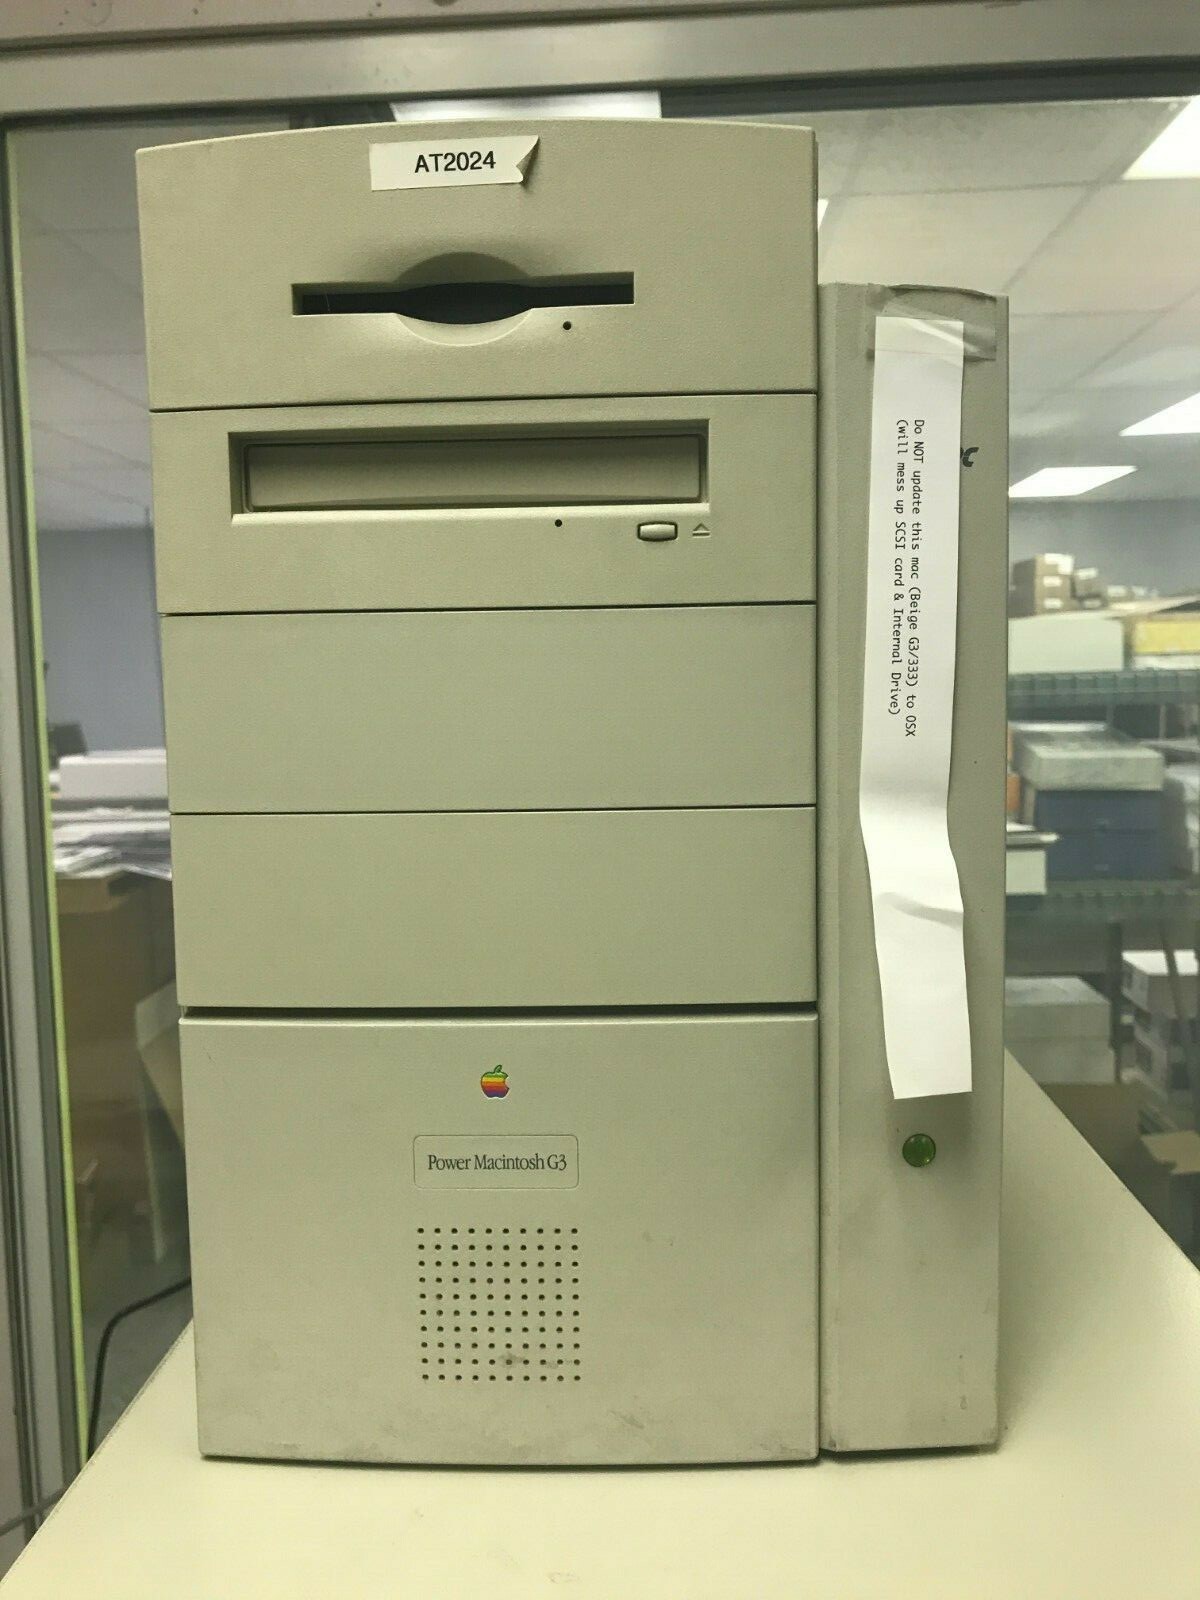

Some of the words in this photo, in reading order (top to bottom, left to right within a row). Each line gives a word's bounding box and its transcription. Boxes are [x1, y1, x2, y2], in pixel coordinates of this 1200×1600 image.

[414, 151, 497, 173] AT2024
[897, 419, 909, 455] (will
[914, 419, 925, 435] Do
[913, 441, 925, 464] NOT
[897, 462, 905, 492] mess
[894, 499, 904, 515] up
[911, 470, 924, 515] update
[895, 521, 907, 550] SCSI
[911, 521, 923, 551] this
[894, 557, 905, 587] card
[911, 557, 920, 579] mac
[894, 592, 905, 602] &
[907, 586, 922, 631] (Beige
[892, 608, 904, 665] Internal
[906, 636, 920, 687] G3/333)
[888, 672, 902, 715] Drive)
[906, 693, 917, 709] to
[906, 714, 917, 737] OSX
[428, 1155, 471, 1170] Power
[474, 1153, 545, 1170] Macintosh
[547, 1154, 567, 1171] G3
